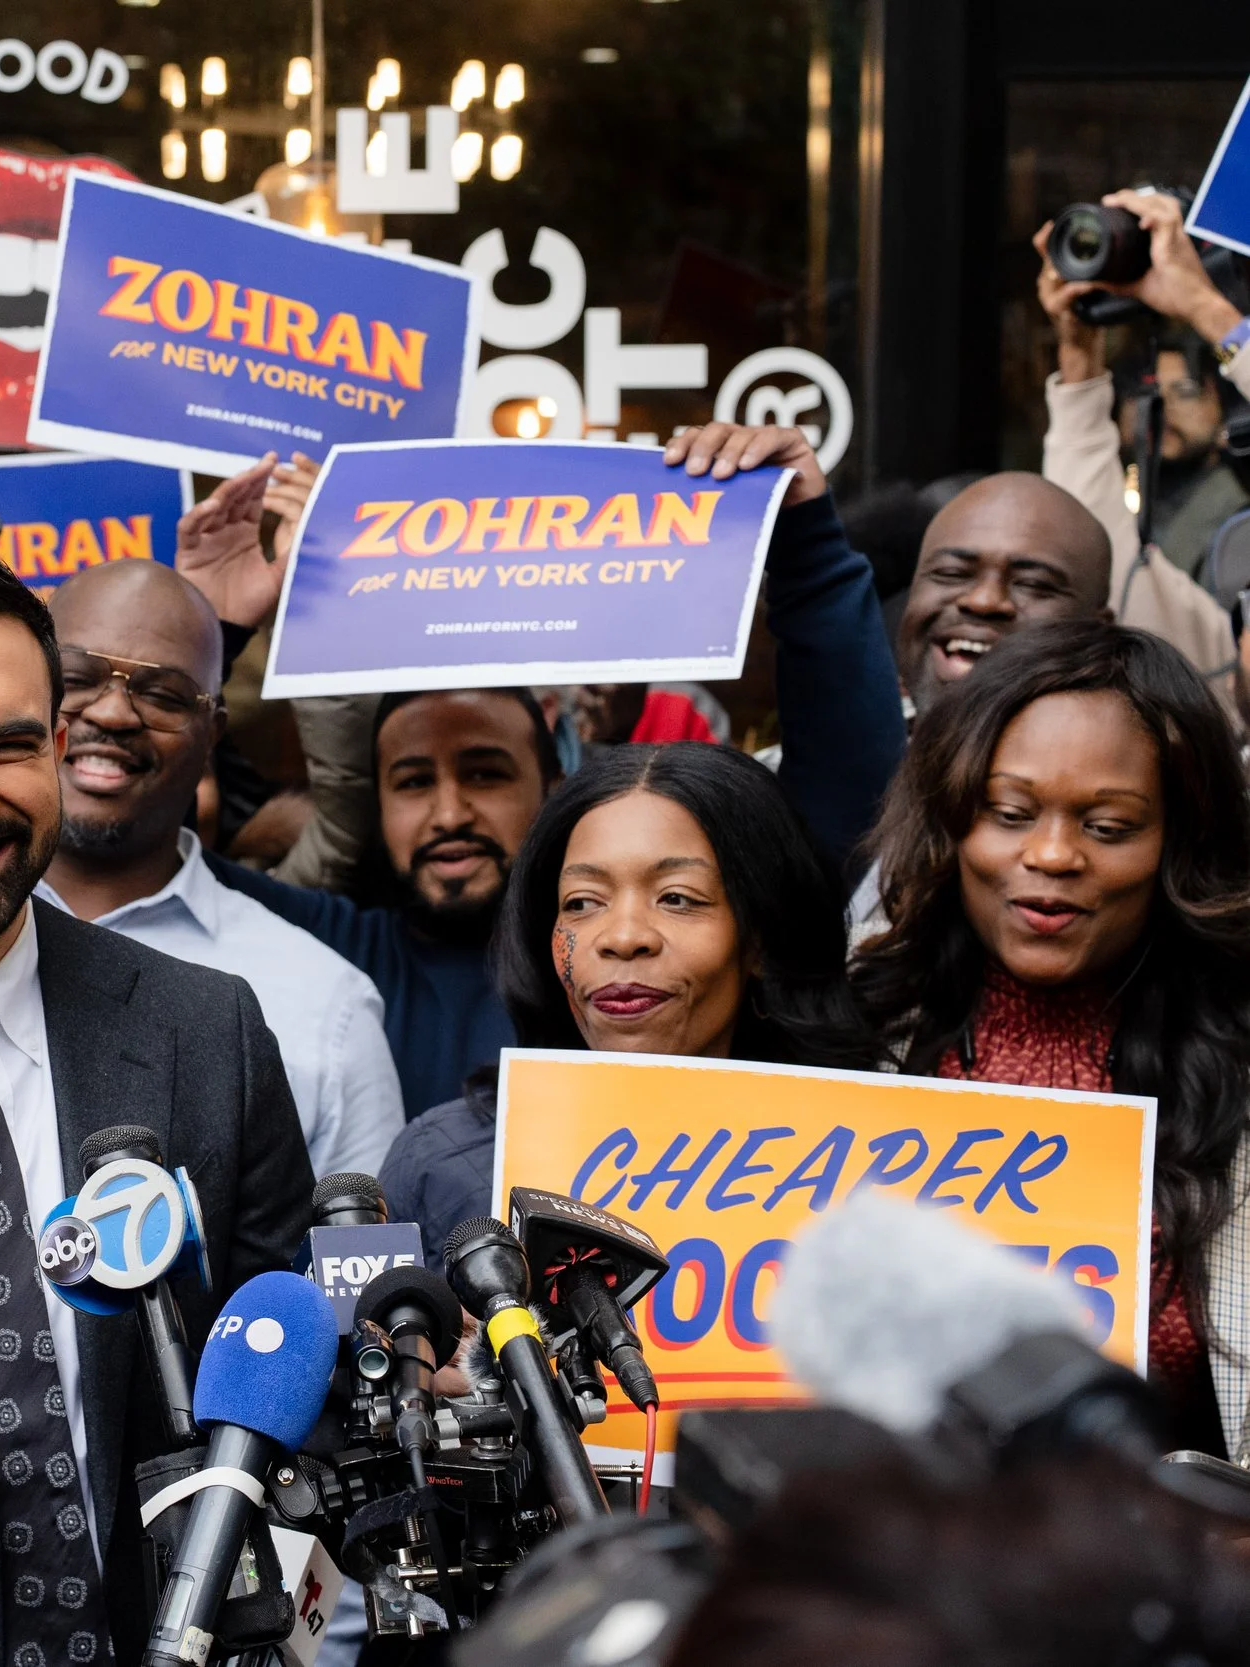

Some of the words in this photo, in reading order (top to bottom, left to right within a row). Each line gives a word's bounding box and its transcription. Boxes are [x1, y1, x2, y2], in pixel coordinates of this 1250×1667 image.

[100, 256, 429, 391] ZOHRAN
[110, 340, 156, 360] FOR
[161, 342, 238, 377] NEW
[245, 359, 328, 401] YORK
[334, 381, 405, 421] CITY
[186, 403, 323, 443] ZOHRANFORNYC.COM
[340, 490, 723, 559] ZOHRAN
[348, 572, 397, 597] FOR
[403, 566, 487, 591] NEW
[495, 561, 592, 588] YORK
[598, 557, 684, 584] CITY
[425, 619, 578, 635] ZOHRANFORNYC.COM
[570, 1125, 1069, 1214] CHEAPER
[40, 1231, 96, 1269] abc
[85, 1172, 175, 1283] 7
[552, 1203, 621, 1231] NEWS
[322, 1255, 389, 1286] FOX
[326, 1286, 362, 1298] NEW
[207, 1315, 244, 1342] FP
[306, 1608, 325, 1637] 47
